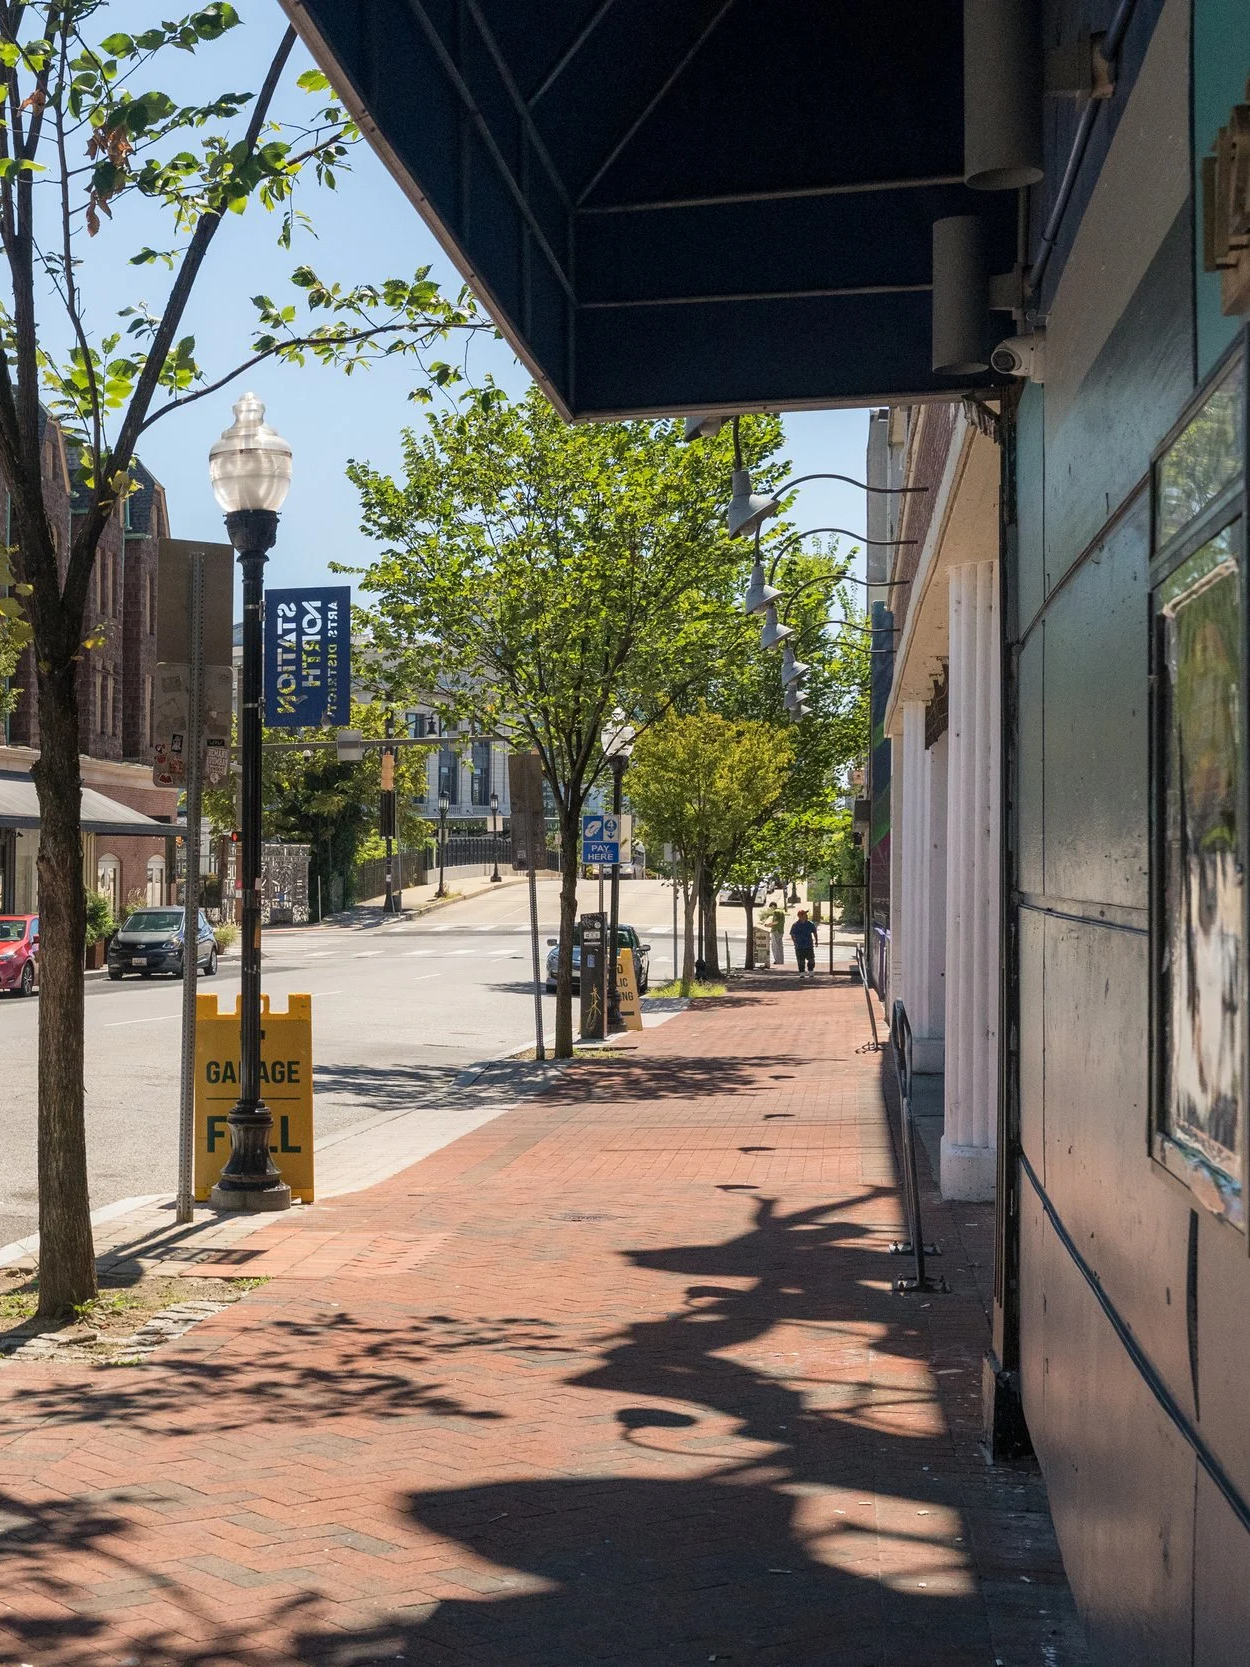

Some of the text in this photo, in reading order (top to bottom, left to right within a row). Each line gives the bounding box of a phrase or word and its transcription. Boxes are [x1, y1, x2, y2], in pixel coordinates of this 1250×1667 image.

[587, 853, 614, 861] HERE
[206, 1060, 300, 1084] GAAGE
[206, 1115, 301, 1153] FL
